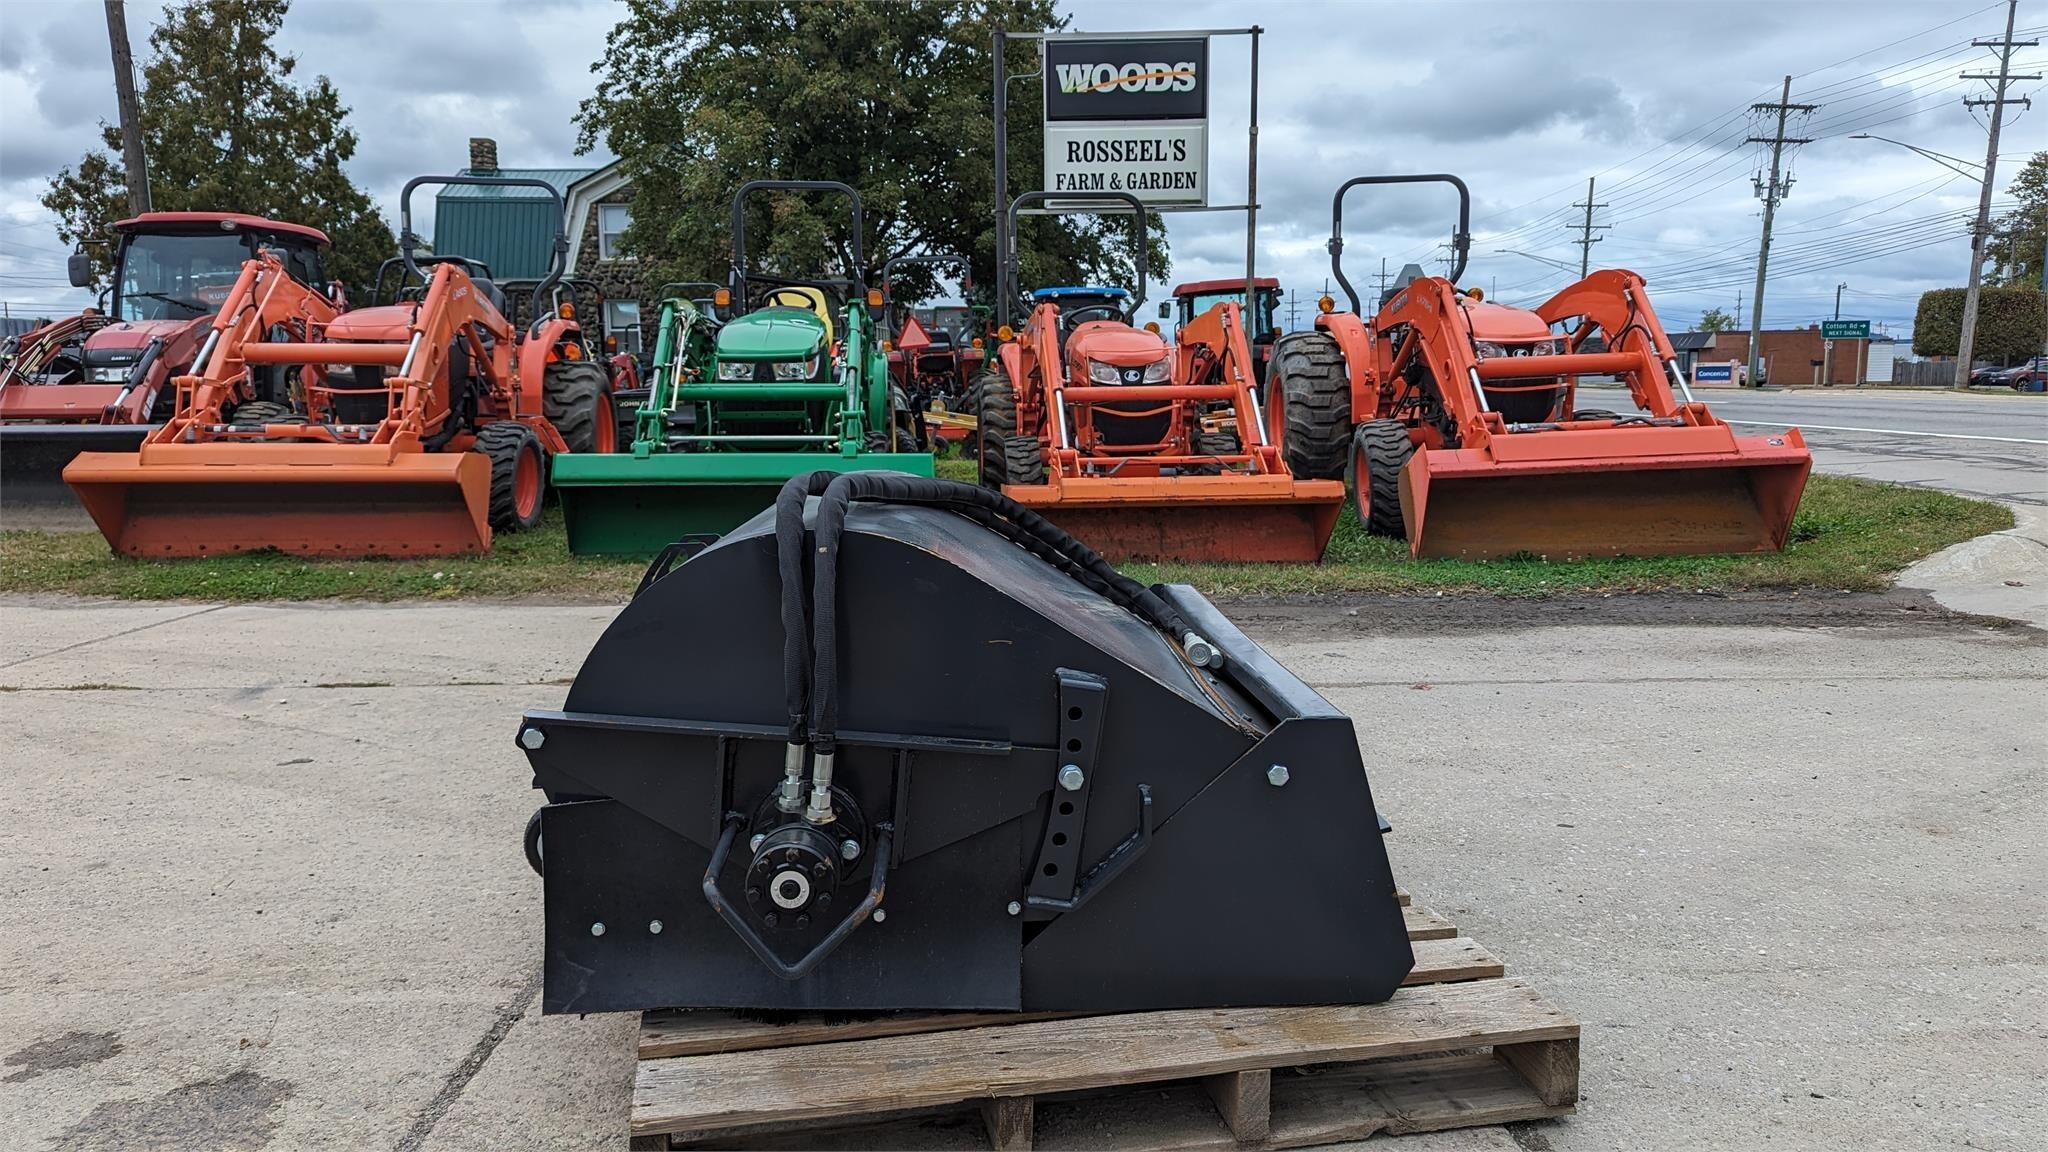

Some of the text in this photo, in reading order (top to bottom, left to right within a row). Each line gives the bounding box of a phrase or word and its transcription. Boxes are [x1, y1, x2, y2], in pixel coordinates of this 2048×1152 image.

[1055, 61, 1197, 93] WOODS
[1066, 138, 1187, 163] ROSSEEL'S
[1055, 171, 1197, 191] FARM & GARDEN
